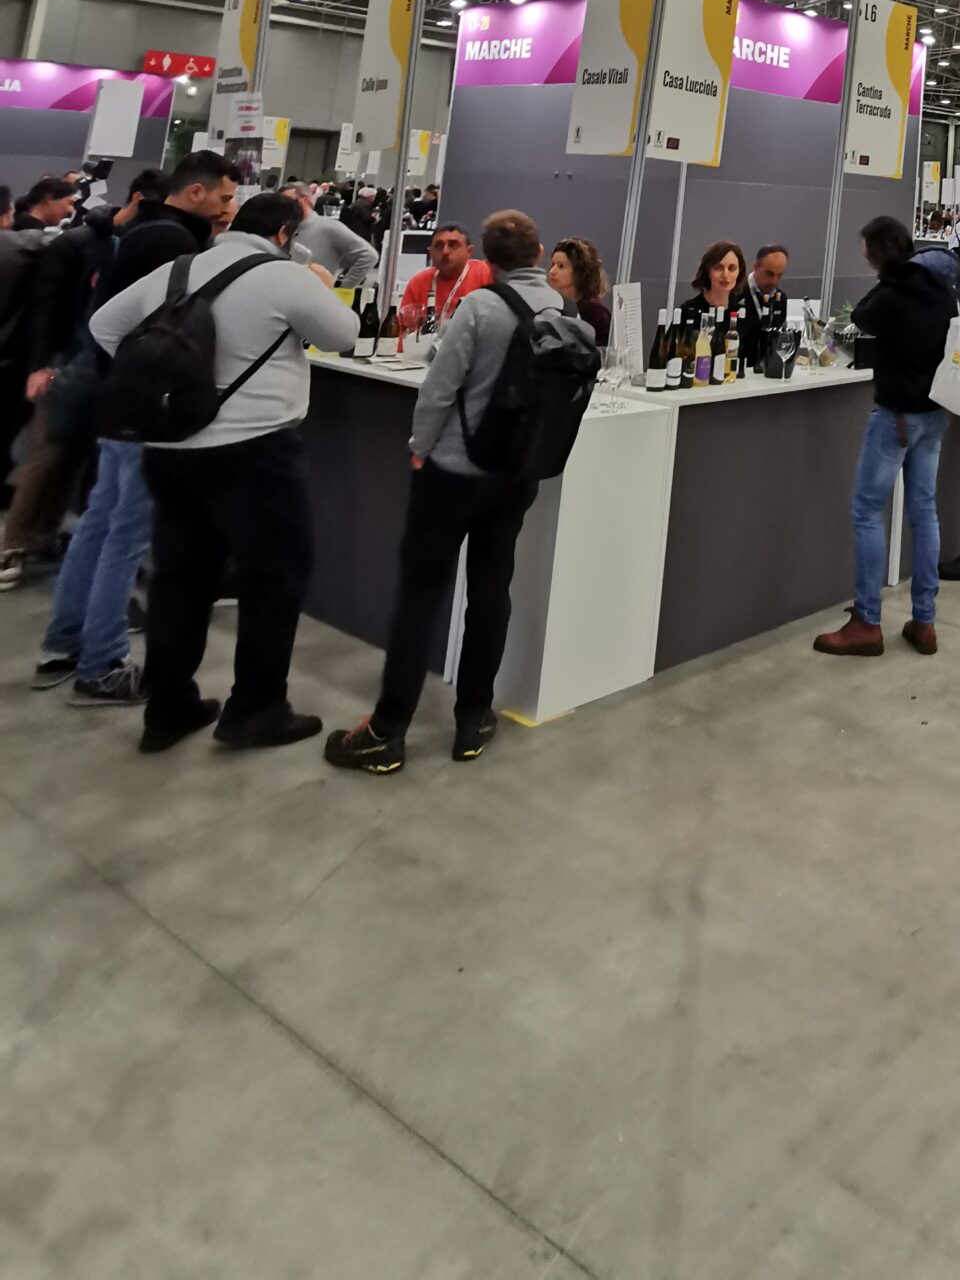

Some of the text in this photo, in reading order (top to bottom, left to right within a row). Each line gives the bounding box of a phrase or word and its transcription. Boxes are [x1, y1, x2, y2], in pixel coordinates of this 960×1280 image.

[865, 3, 878, 23] L6
[904, 14, 912, 51] MARCHE
[465, 38, 533, 61] MARCHE
[582, 67, 629, 85] Casale Vitali
[663, 70, 718, 97] Casa Lucciola
[857, 82, 883, 101] Cantina
[856, 99, 892, 119] Terracruda
